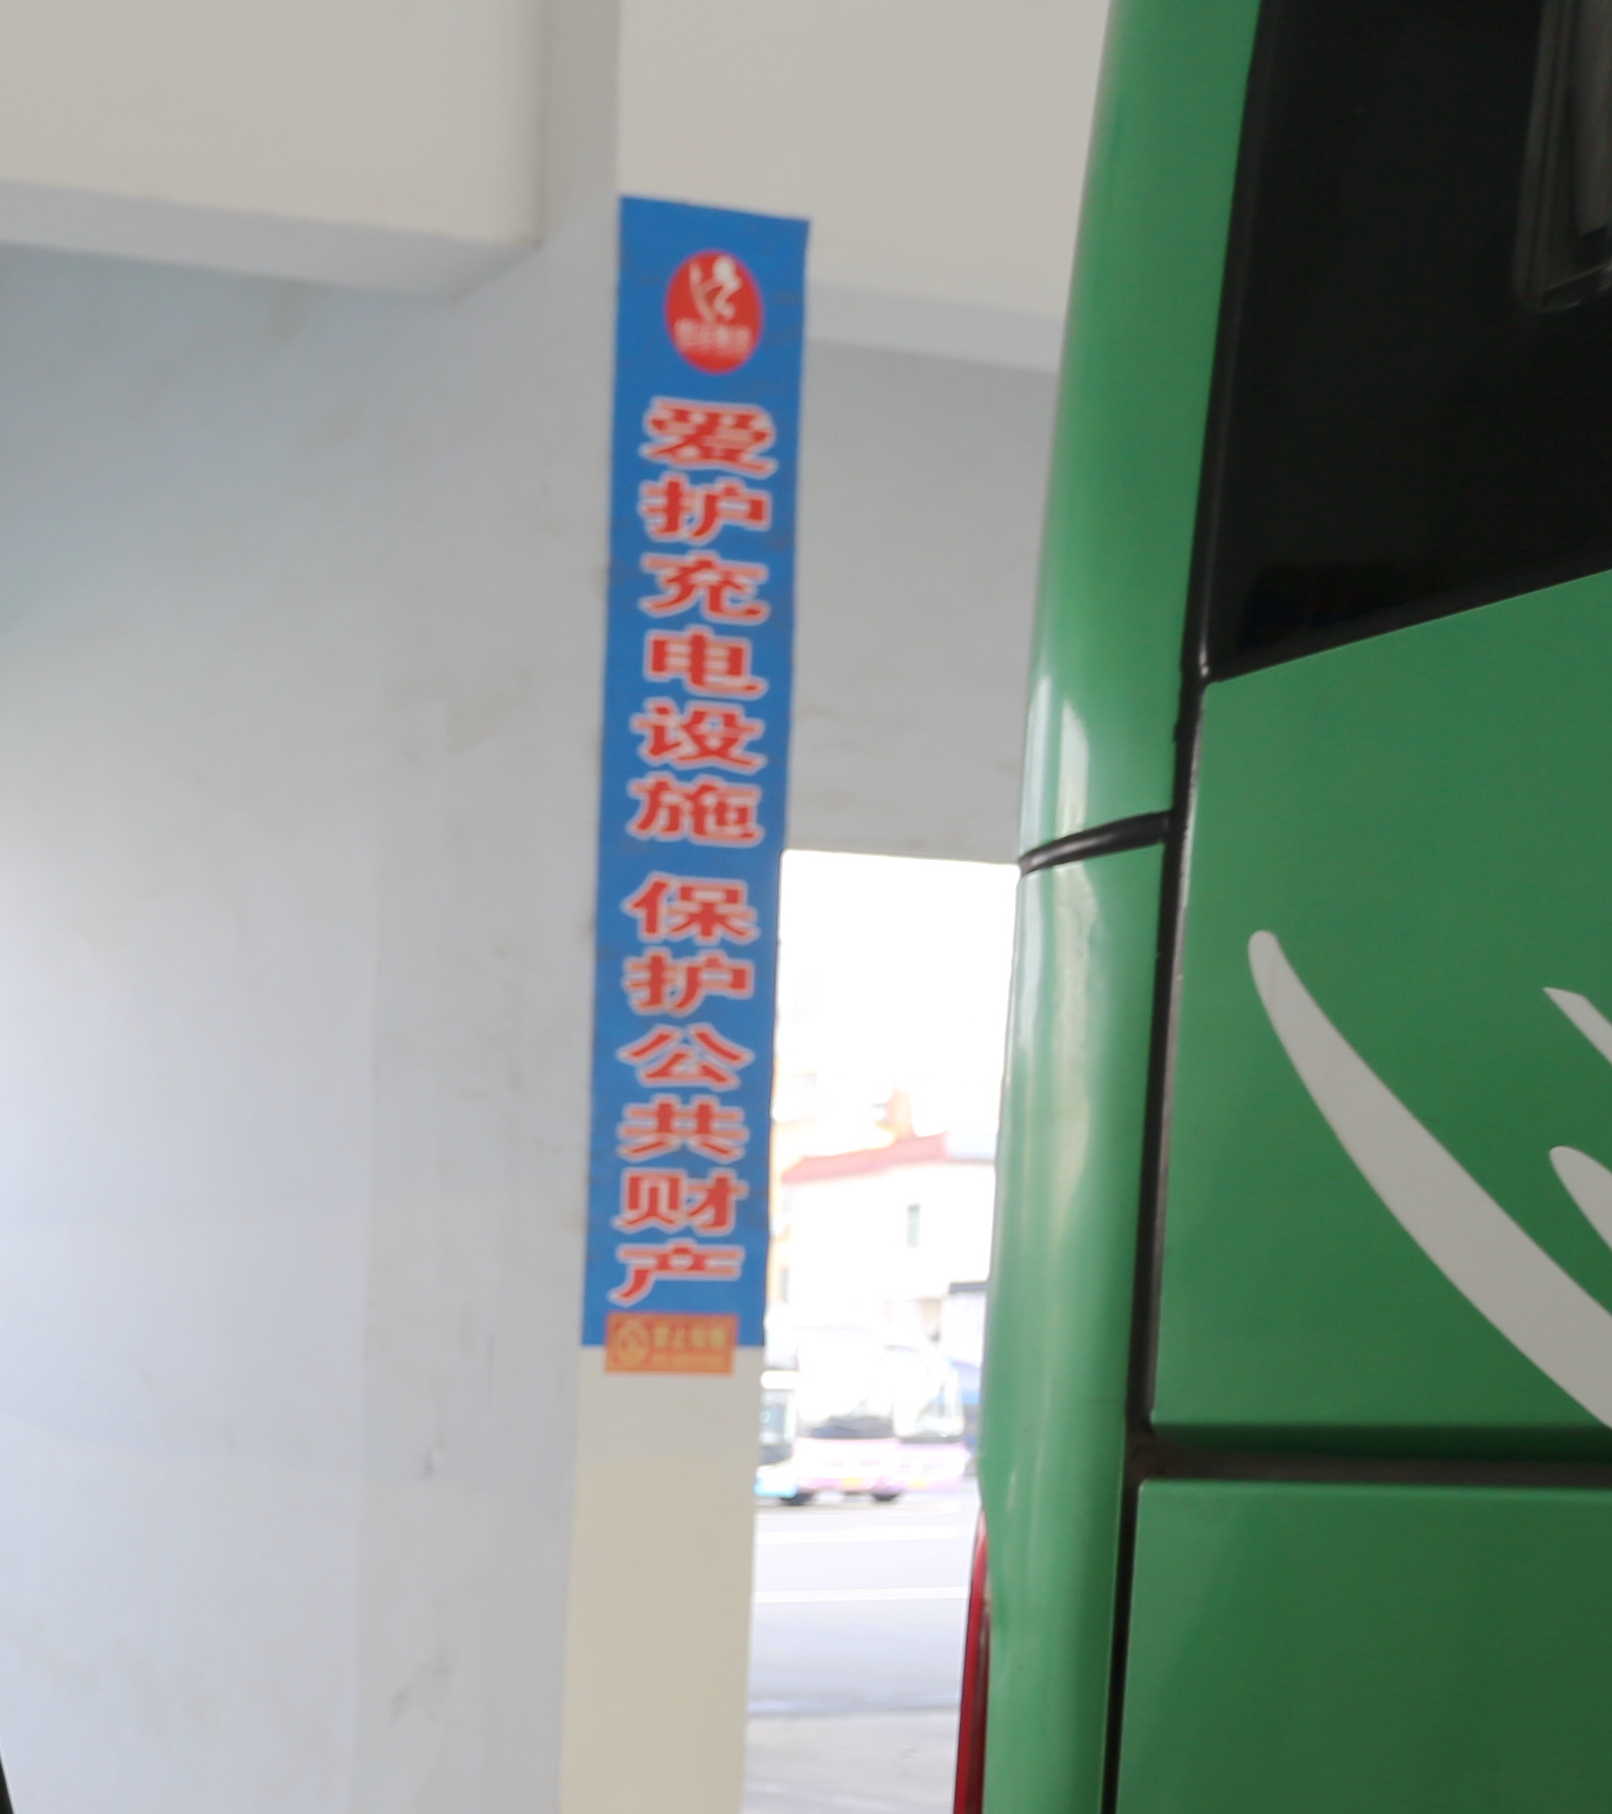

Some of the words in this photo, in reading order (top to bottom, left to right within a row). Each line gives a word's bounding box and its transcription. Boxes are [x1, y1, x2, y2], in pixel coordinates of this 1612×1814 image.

[625, 394, 778, 847] 爱护充电设施
[607, 870, 761, 1308] 保护公共财产
